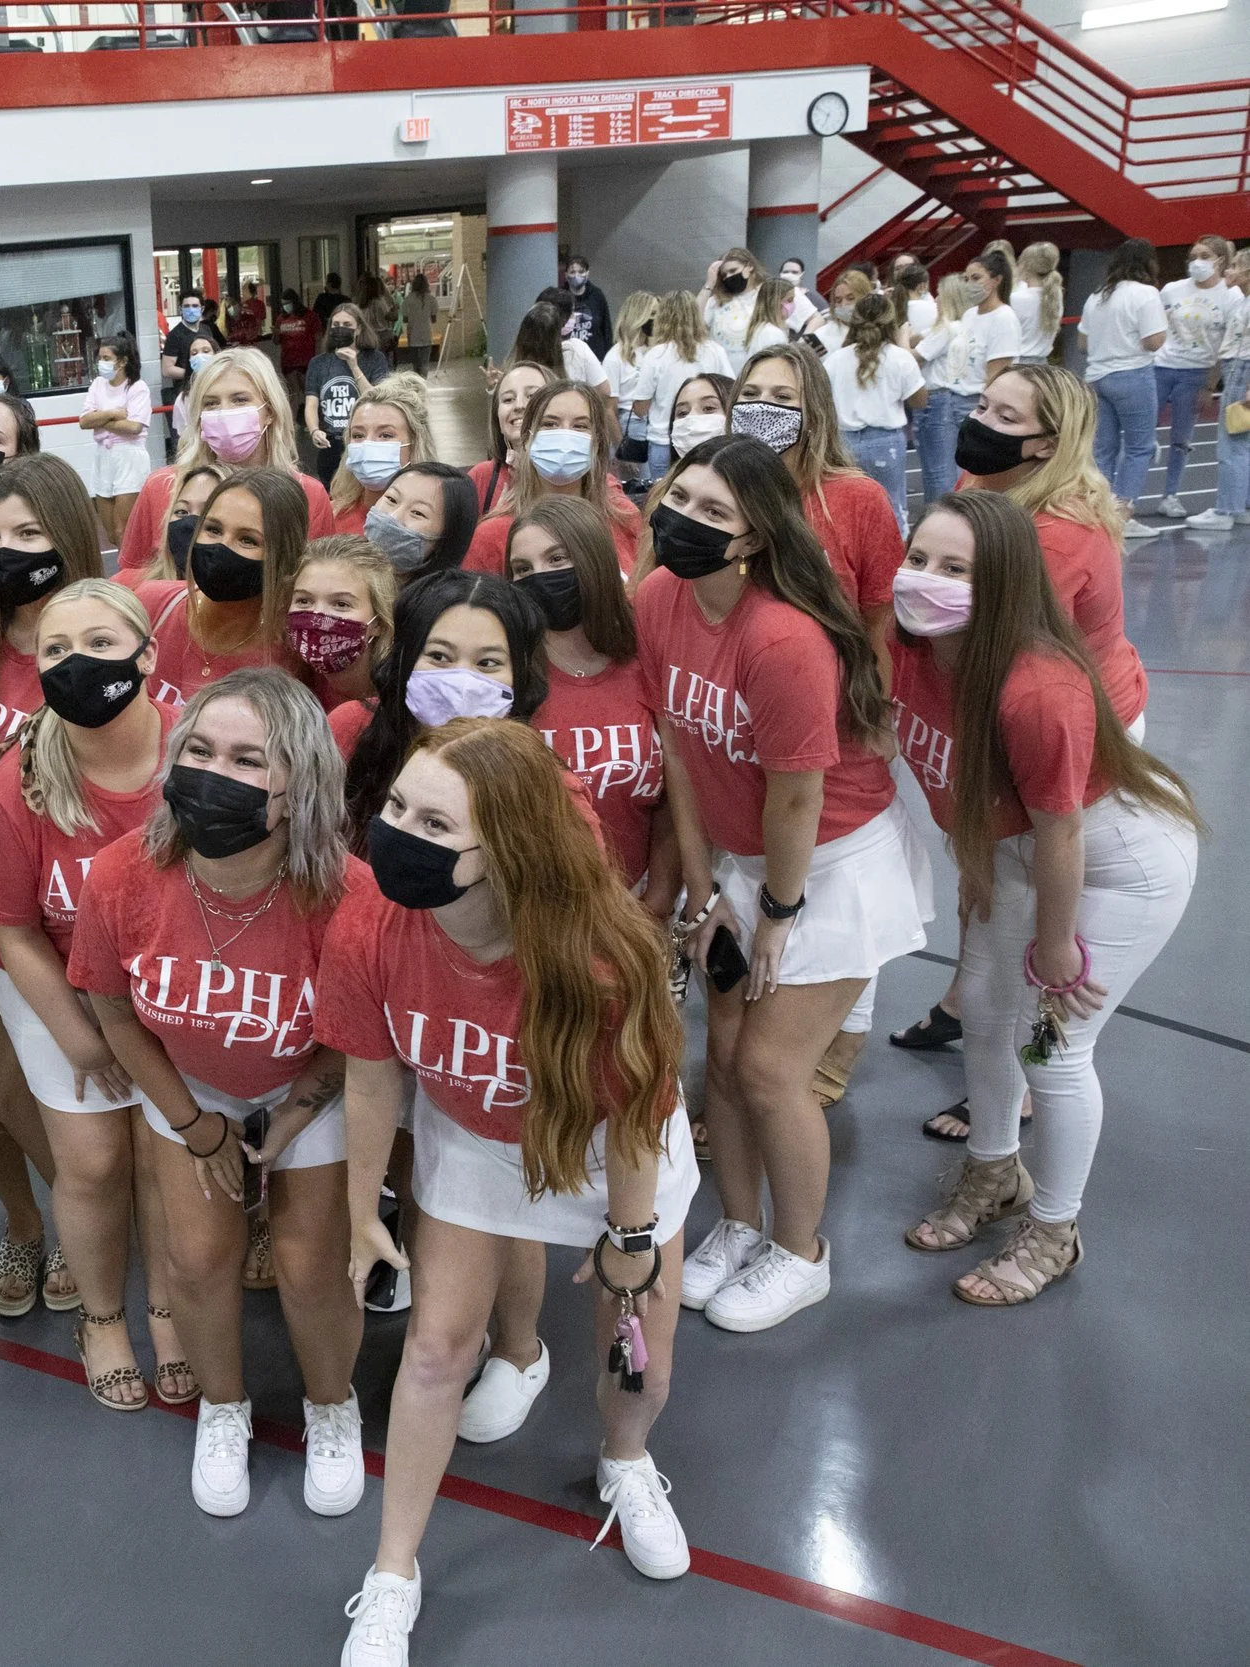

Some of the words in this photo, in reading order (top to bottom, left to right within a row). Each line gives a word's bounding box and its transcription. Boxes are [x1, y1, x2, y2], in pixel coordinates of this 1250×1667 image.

[406, 118, 430, 140] EXIT
[330, 384, 350, 398] TRI
[320, 397, 356, 417] SIGM
[663, 665, 755, 738] LPHA
[190, 1018, 216, 1030] 1872
[448, 1077, 473, 1093] 1872
